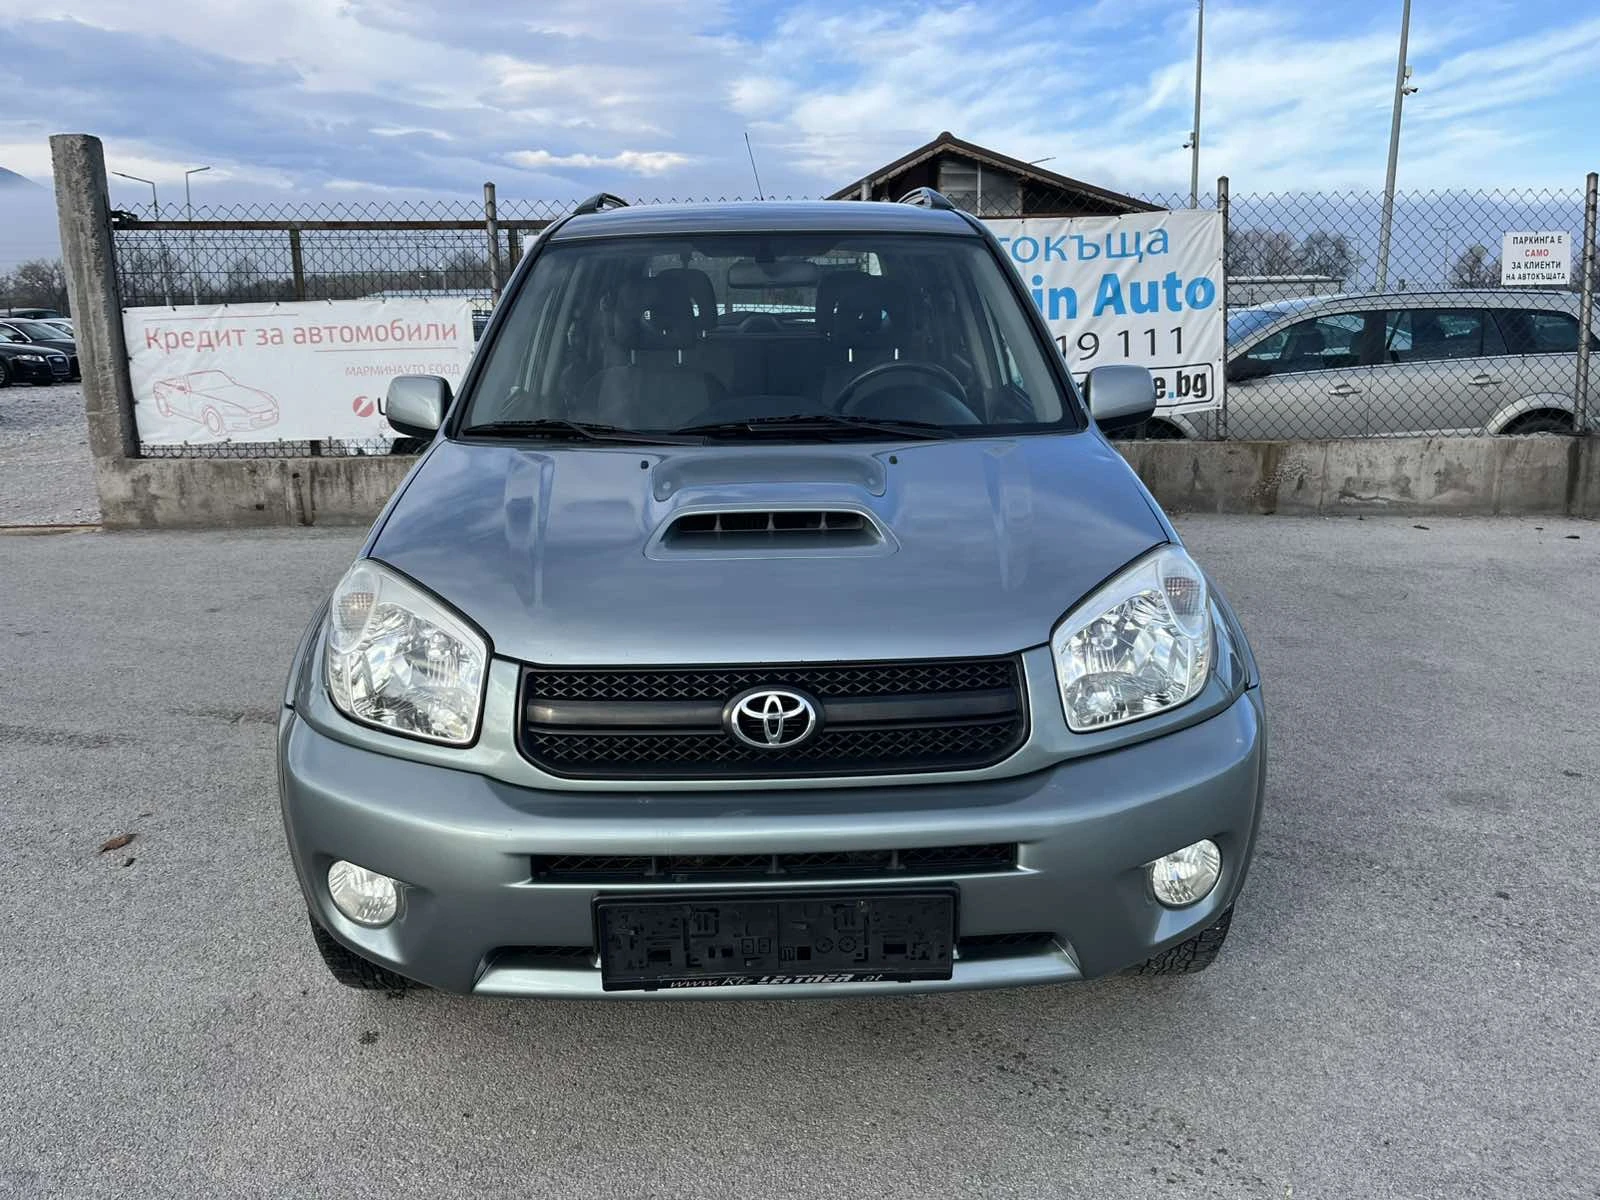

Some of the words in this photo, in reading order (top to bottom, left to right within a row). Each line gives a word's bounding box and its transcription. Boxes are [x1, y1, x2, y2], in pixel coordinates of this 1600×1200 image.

[1512, 236, 1555, 245] ПАРКИНГА
[1524, 249, 1550, 257] САМО
[1511, 261, 1522, 270] ЗА
[1524, 261, 1561, 270] КЛИЕНТИ
[1517, 272, 1566, 280] АВТОКЪЩАТА
[1092, 271, 1216, 317] Auto
[144, 327, 247, 354] Кредит
[255, 327, 284, 346] за
[293, 319, 458, 345] автомобили
[1117, 326, 1183, 358] 111
